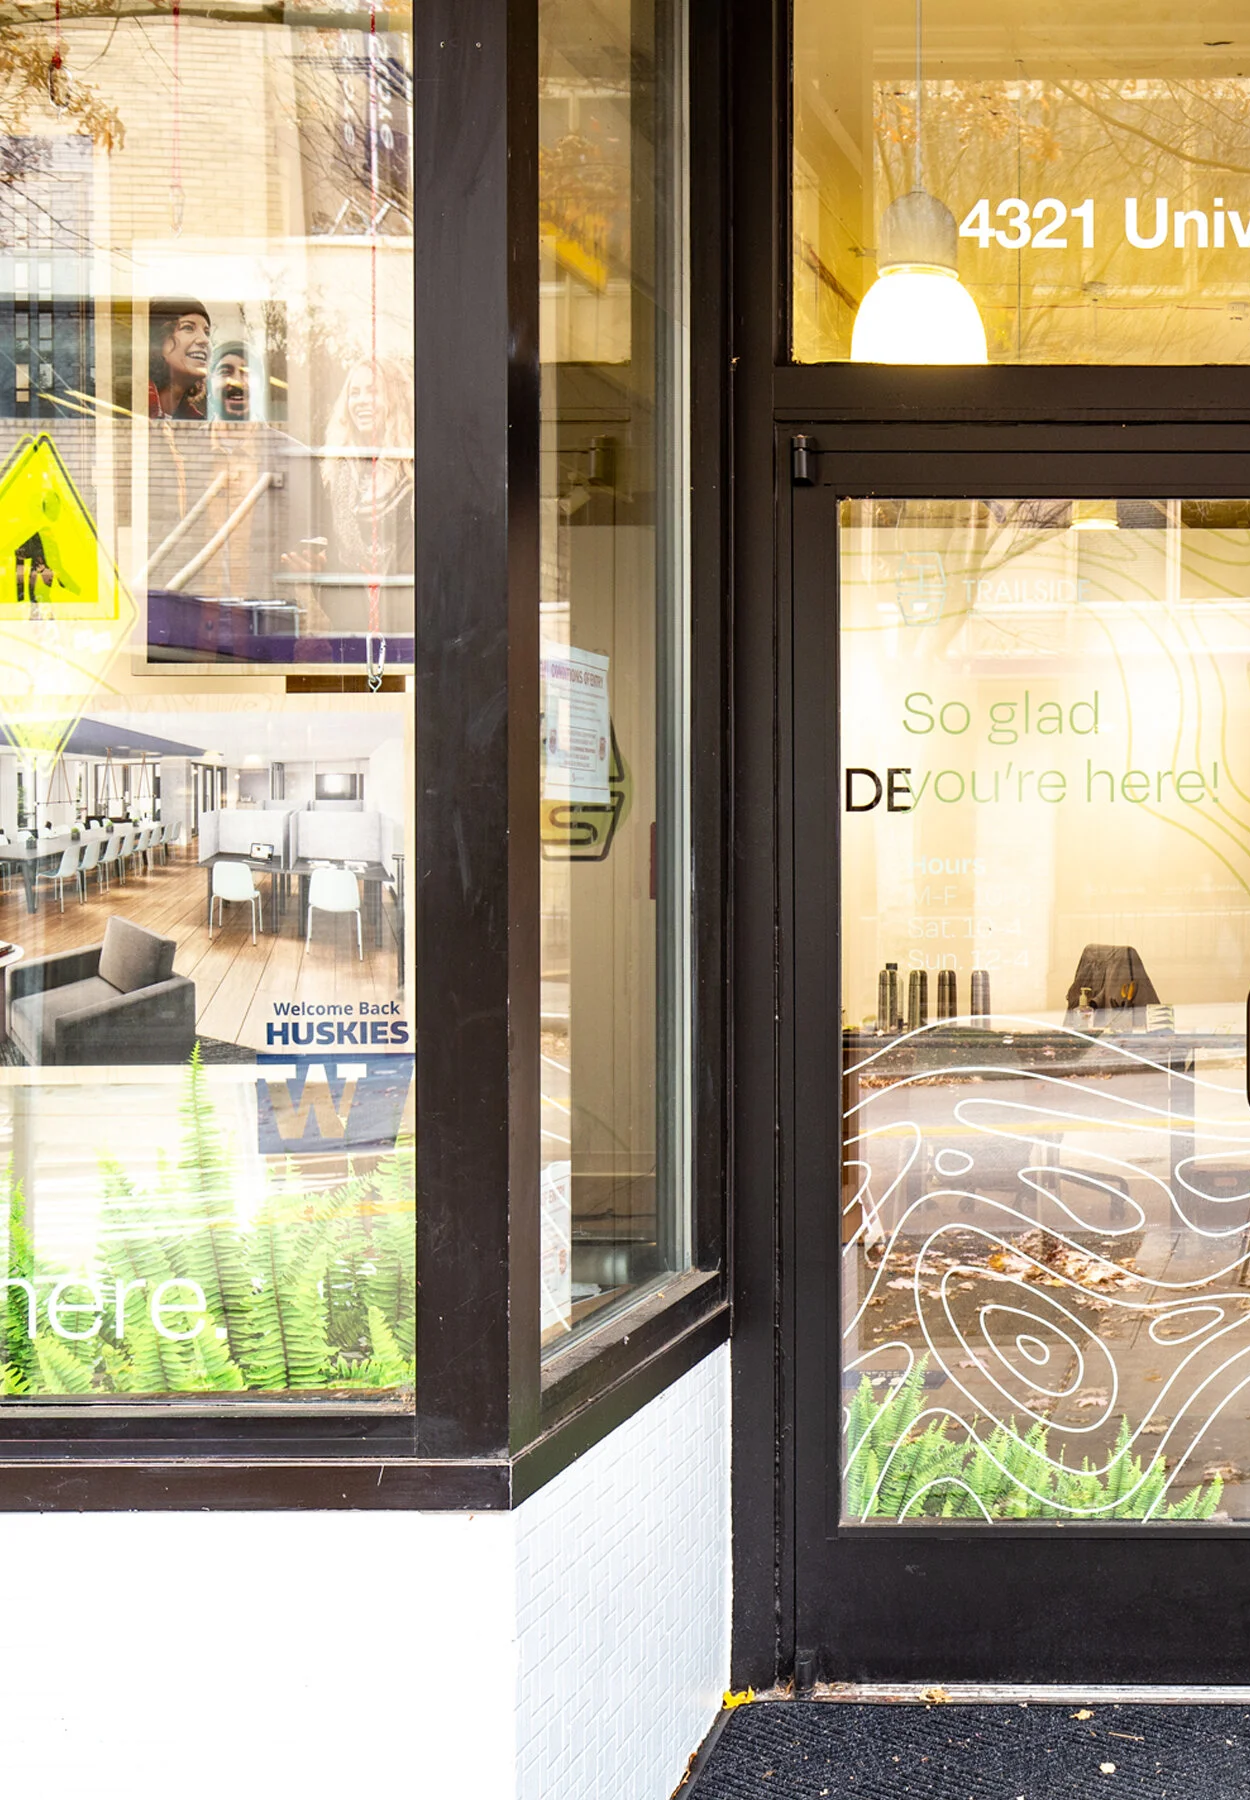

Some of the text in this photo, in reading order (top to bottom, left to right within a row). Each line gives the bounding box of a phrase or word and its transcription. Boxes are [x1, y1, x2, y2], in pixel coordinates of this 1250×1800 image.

[958, 198, 1097, 249] 4321
[961, 579, 1091, 602] TRAILSIDE
[902, 690, 1099, 745] So glad
[900, 758, 1220, 814] you're here!
[908, 855, 987, 876] Hours
[907, 916, 957, 939] Sat.
[907, 948, 963, 971] Sun.
[273, 1000, 401, 1016] Welcome Back
[266, 1020, 409, 1046] HUSKIES
